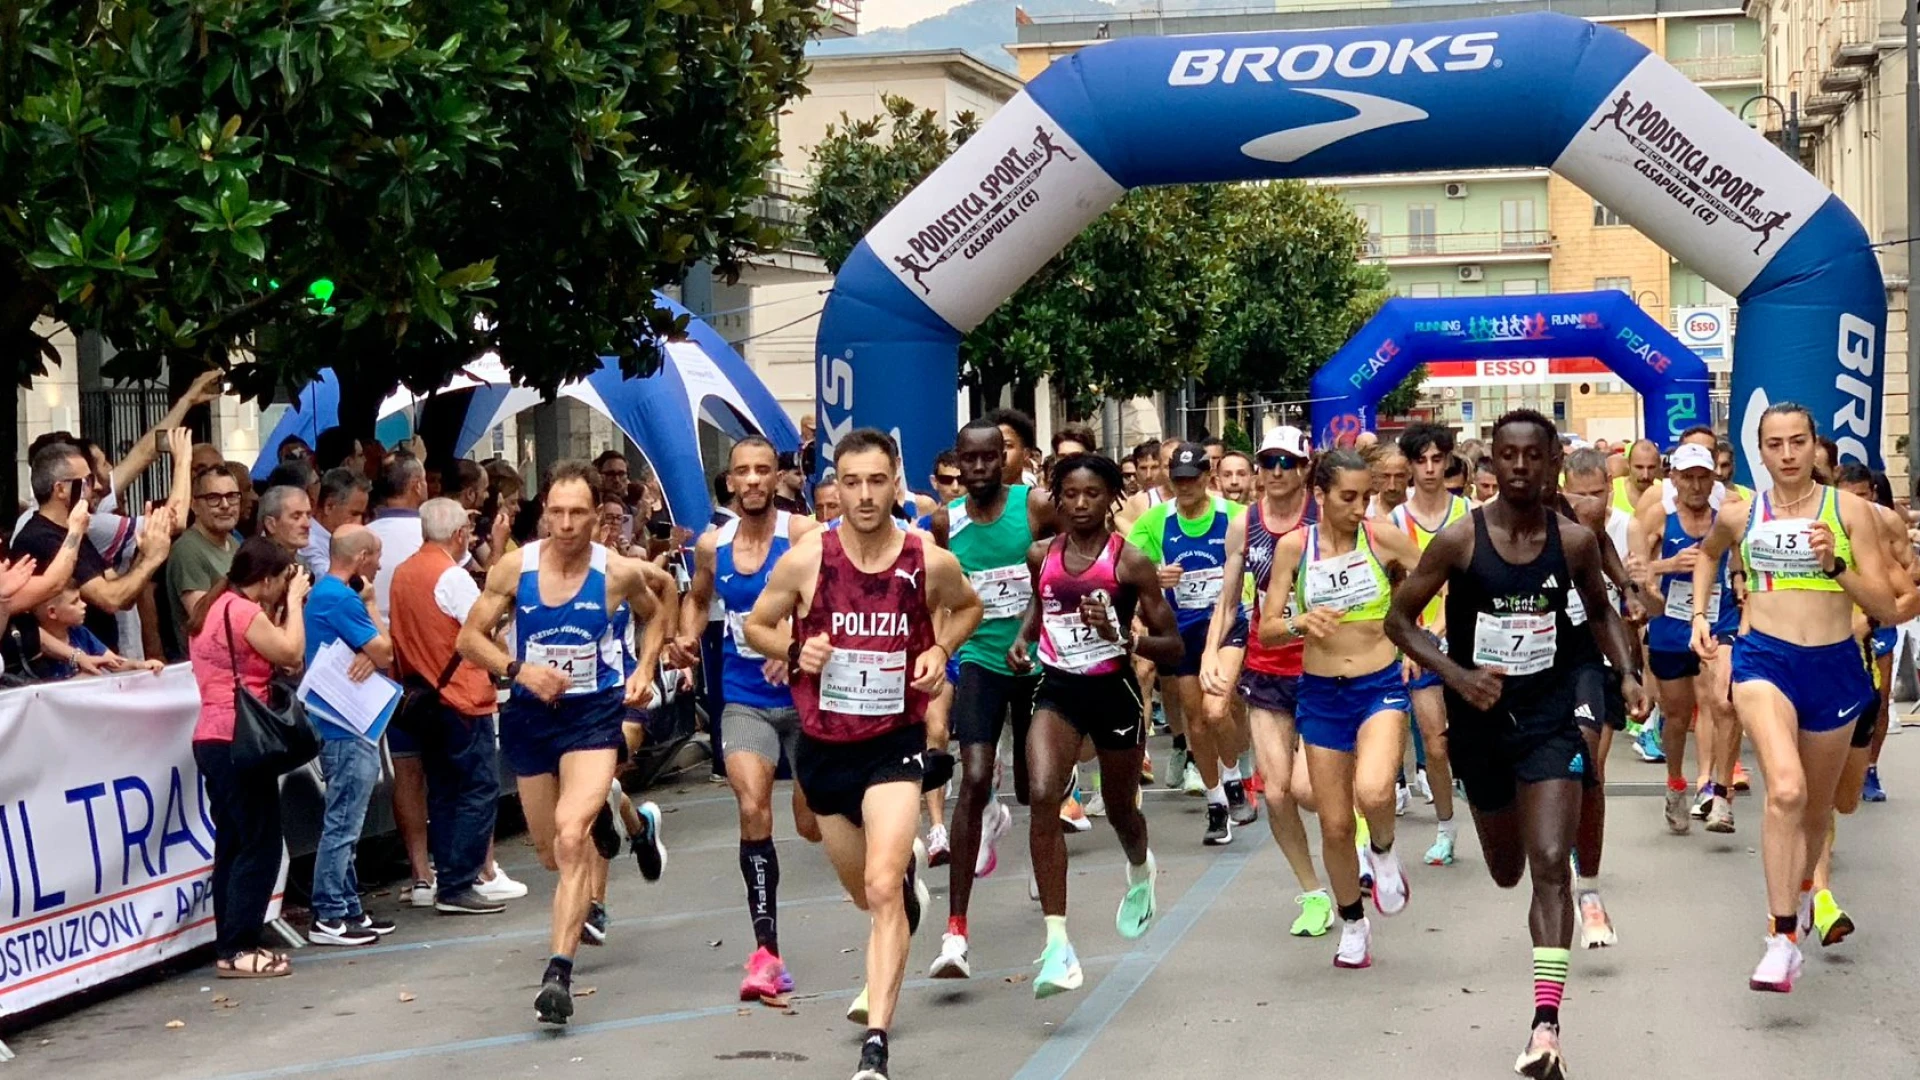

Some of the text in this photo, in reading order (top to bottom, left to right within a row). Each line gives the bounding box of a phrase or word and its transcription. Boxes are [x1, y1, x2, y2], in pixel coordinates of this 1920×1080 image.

[1168, 31, 1499, 86] BROOKS
[1626, 100, 1765, 224] PODISTICA SPORT SRL
[1632, 138, 1691, 187] SPECIALISTA
[1633, 158, 1719, 226] CASAPULLA (CE)
[907, 146, 1044, 262] PODISTICA SPORT SRL
[963, 188, 1041, 261] CASAPULLA (CE)
[943, 210, 997, 259] SPECIALISTA
[1415, 320, 1461, 332] RUNNING
[1551, 313, 1598, 325] RUNNING
[1616, 326, 1672, 374] PEACE
[1349, 338, 1400, 389] PEACE
[1483, 359, 1536, 377] ESSO
[1774, 534, 1798, 549] 13
[1189, 580, 1207, 593] 27
[1328, 570, 1349, 588] 16
[997, 581, 1009, 596] 2
[832, 612, 909, 637] POLIZIA
[1070, 627, 1094, 643] 12
[1511, 635, 1524, 651] 7
[859, 670, 868, 687] 1
[826, 684, 859, 693] DANIELE
